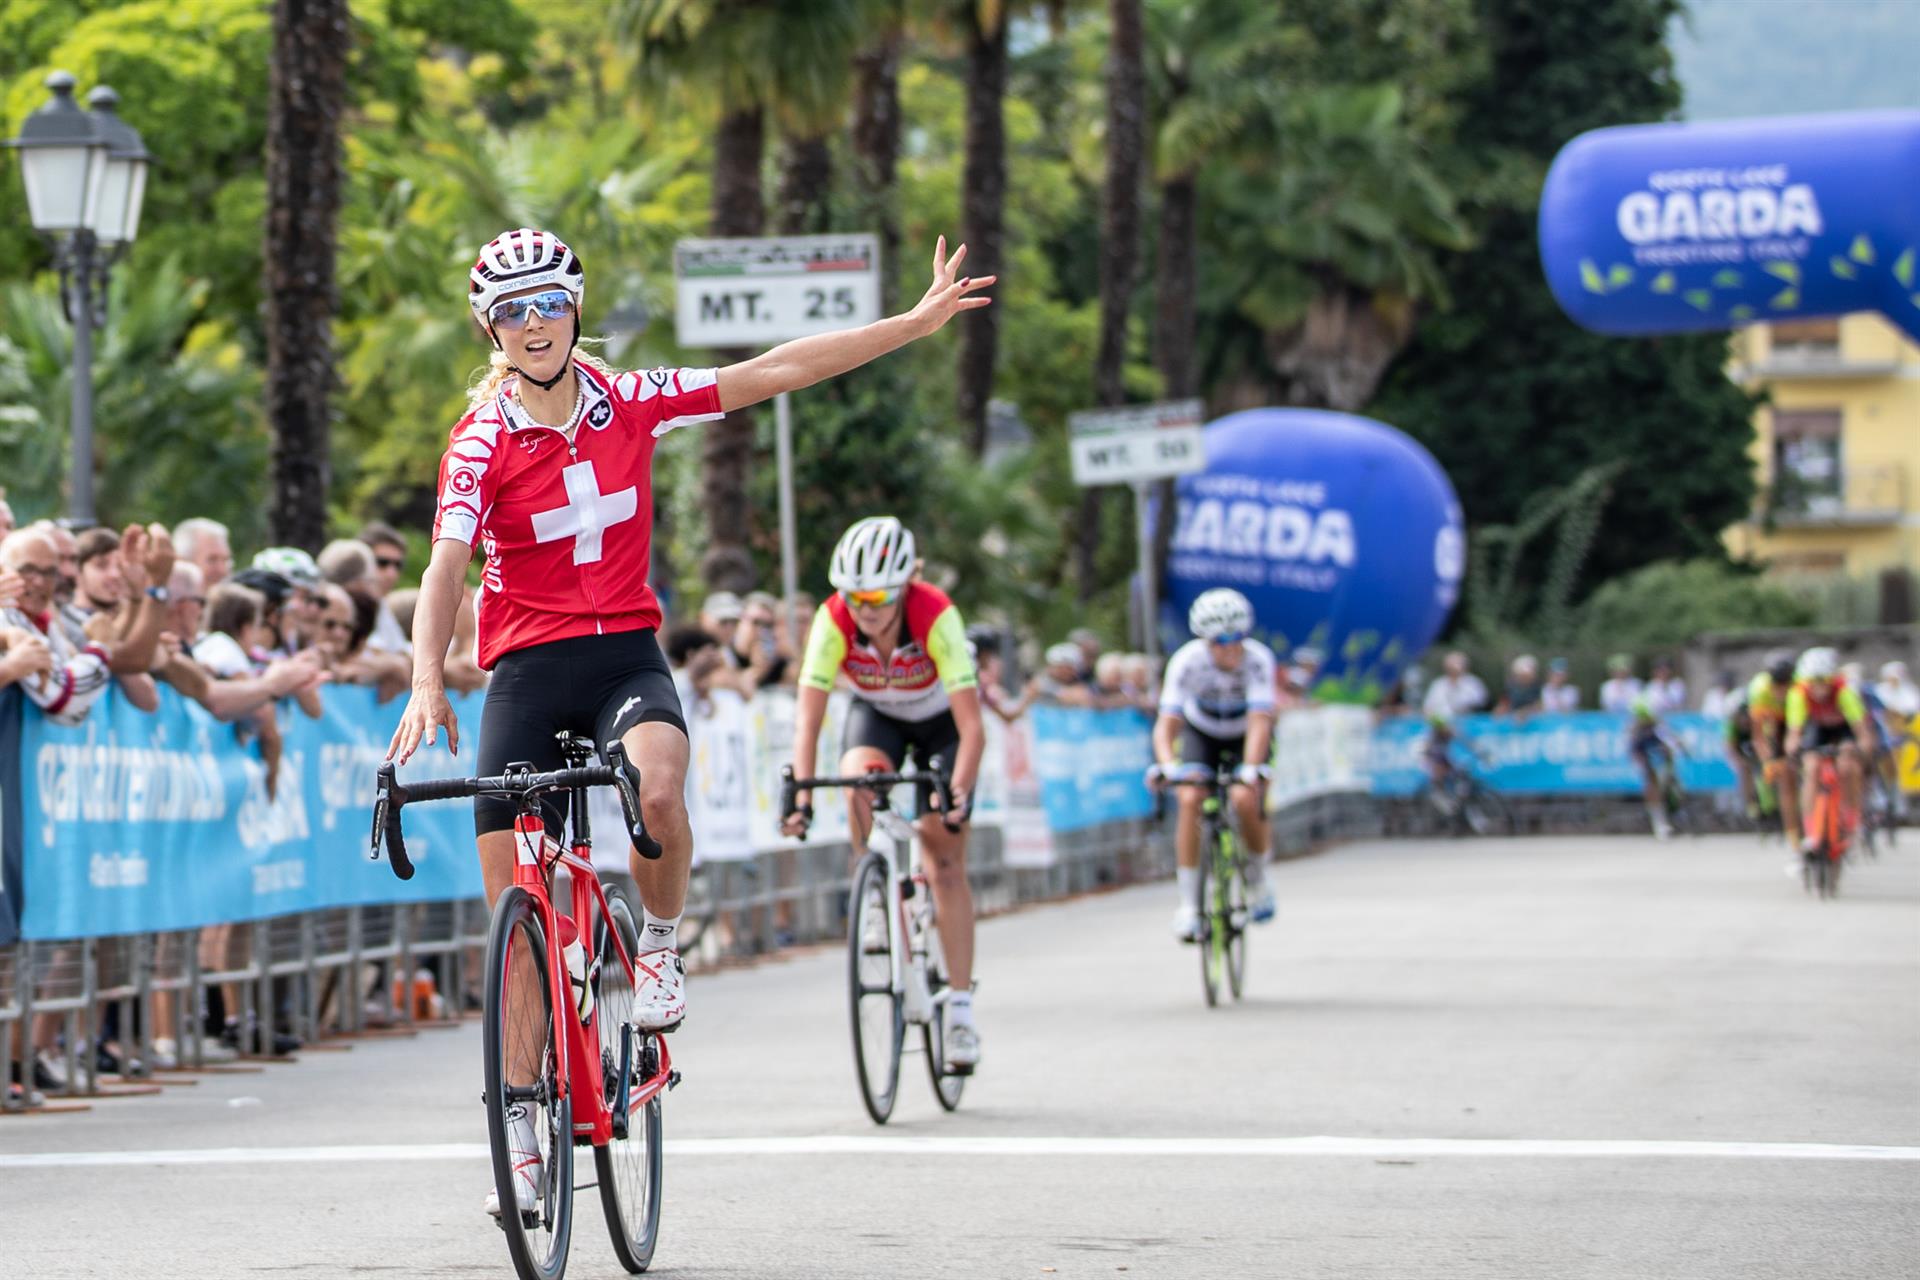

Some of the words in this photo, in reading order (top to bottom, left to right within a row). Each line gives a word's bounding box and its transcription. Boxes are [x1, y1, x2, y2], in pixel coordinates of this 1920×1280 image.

[1616, 184, 1822, 246] GARDA
[700, 290, 773, 321] MT.
[804, 287, 857, 319] 25
[1170, 499, 1357, 568] ARDA
